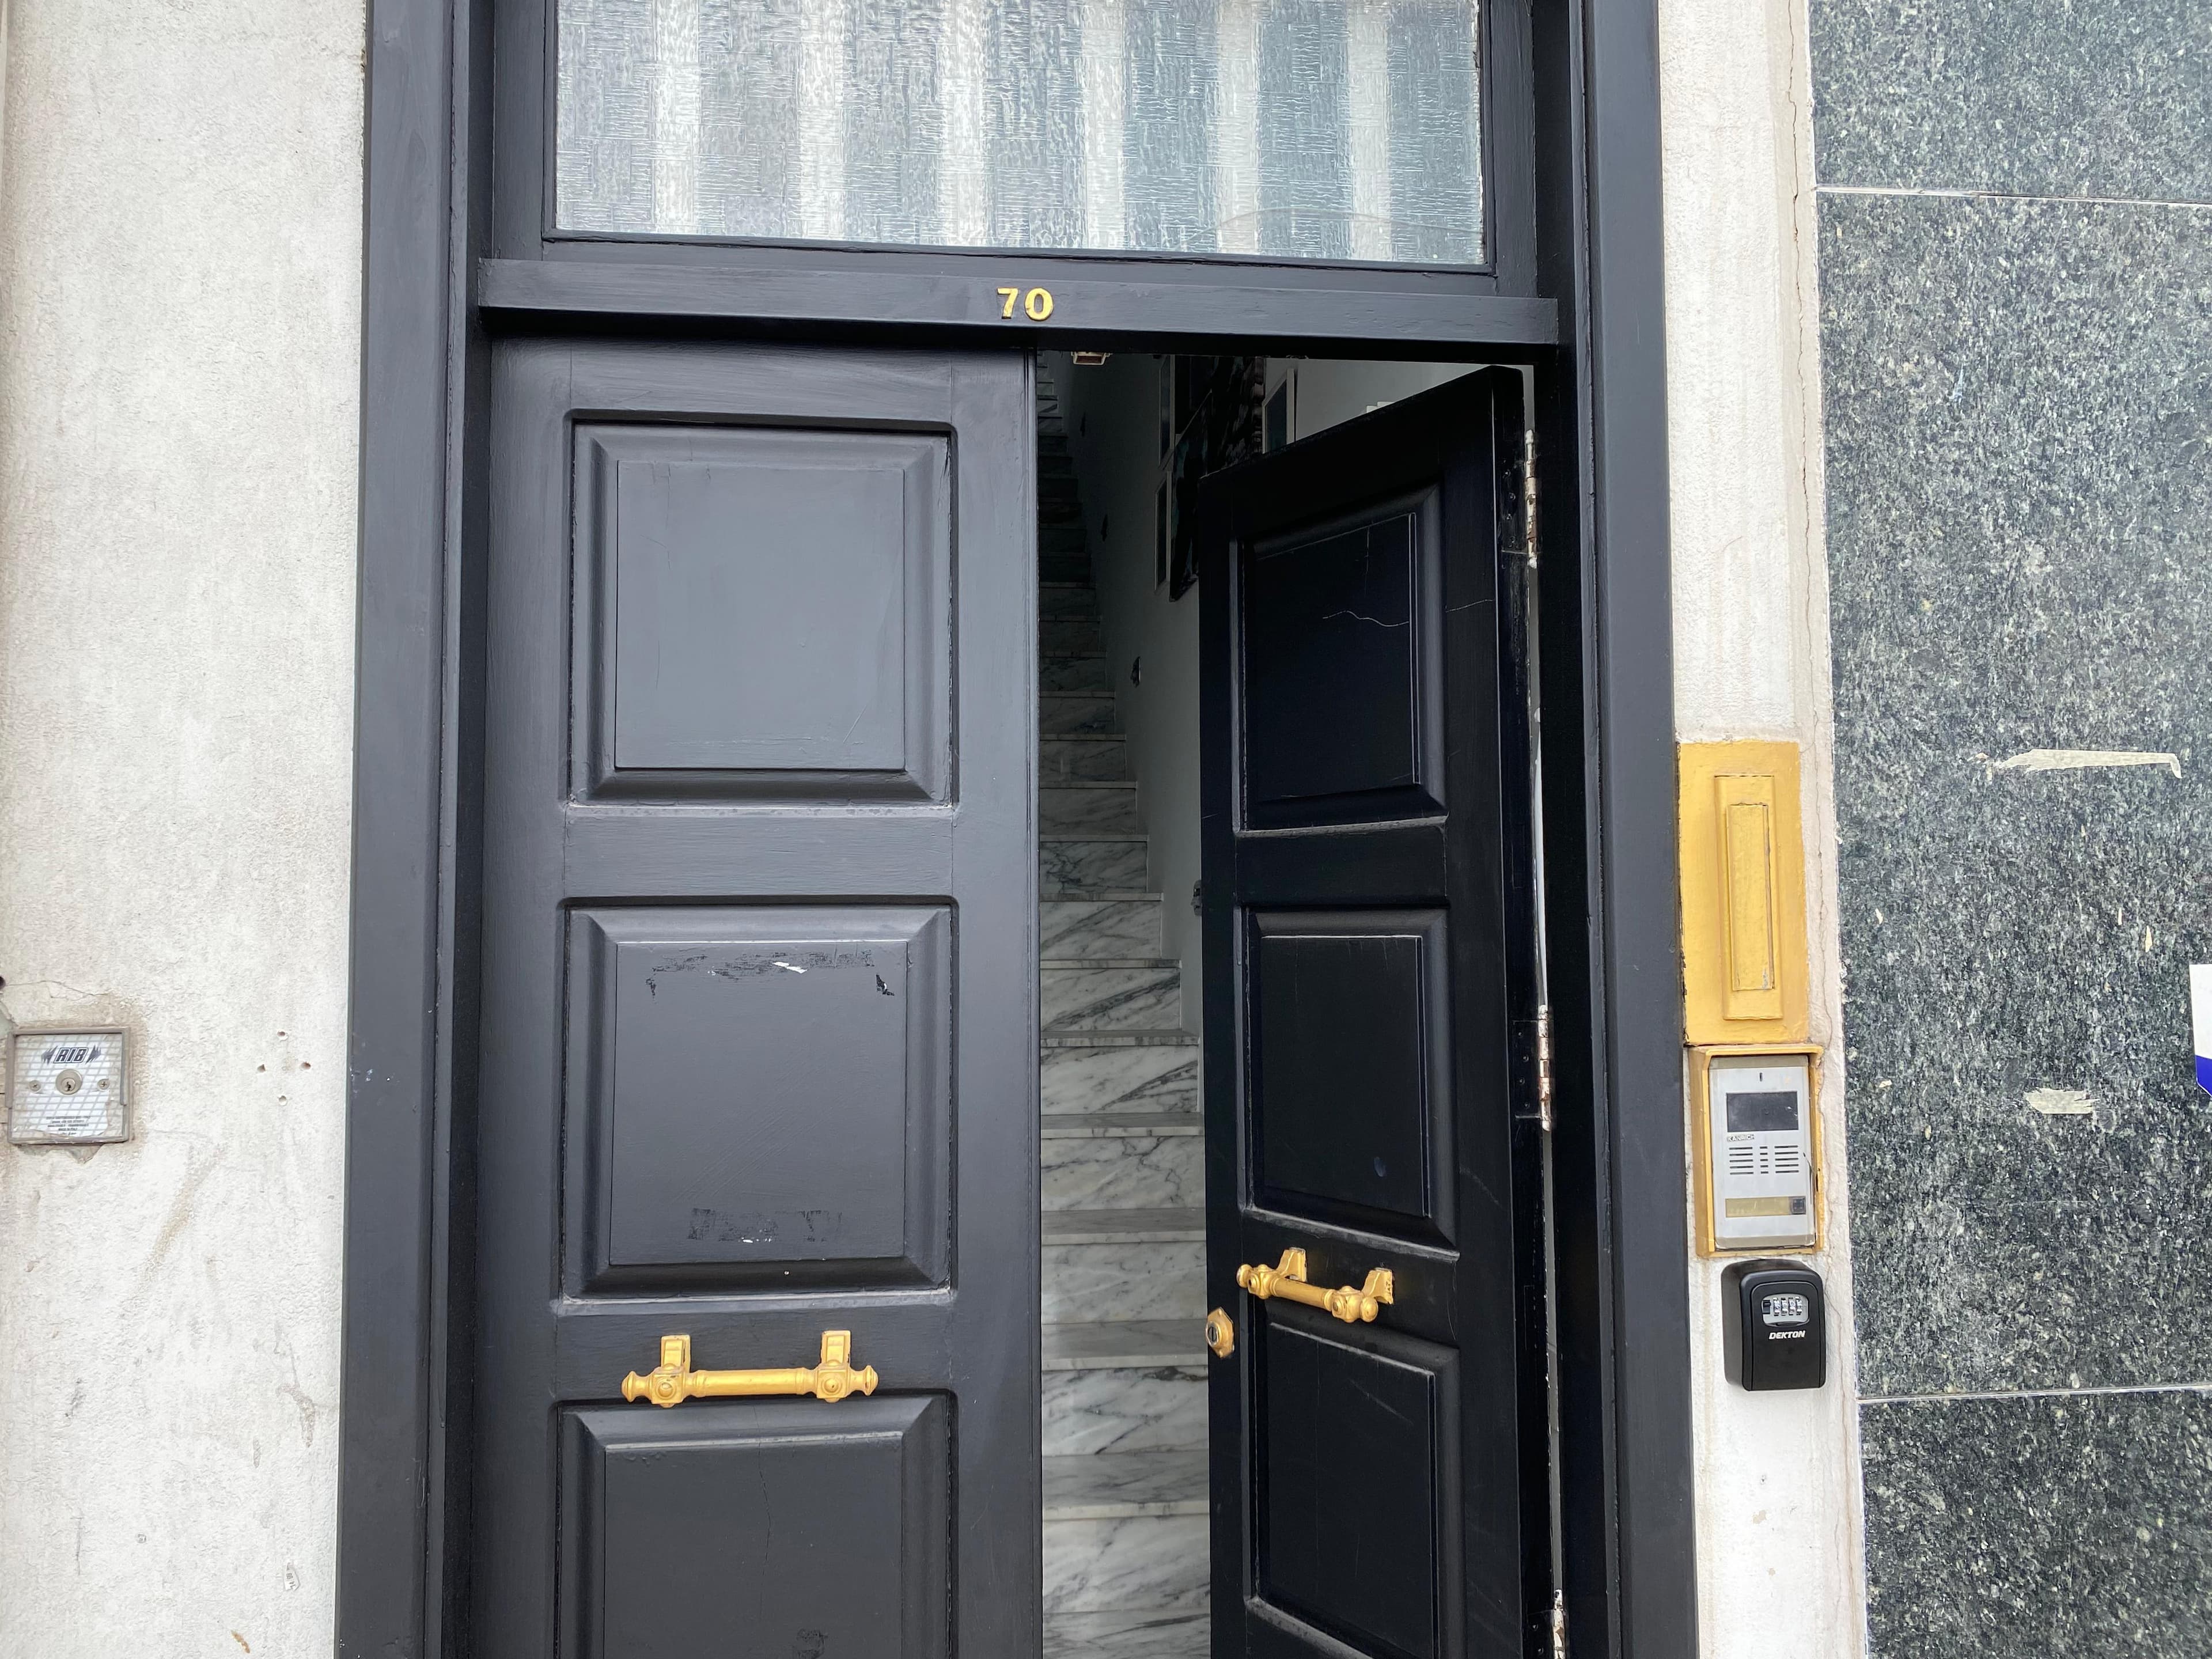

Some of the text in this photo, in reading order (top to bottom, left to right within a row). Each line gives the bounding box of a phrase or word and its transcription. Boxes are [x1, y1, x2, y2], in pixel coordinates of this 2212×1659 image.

[997, 287, 1054, 321] 70
[55, 1048, 88, 1063] RIB
[1768, 1330, 1806, 1340] DEKTON
